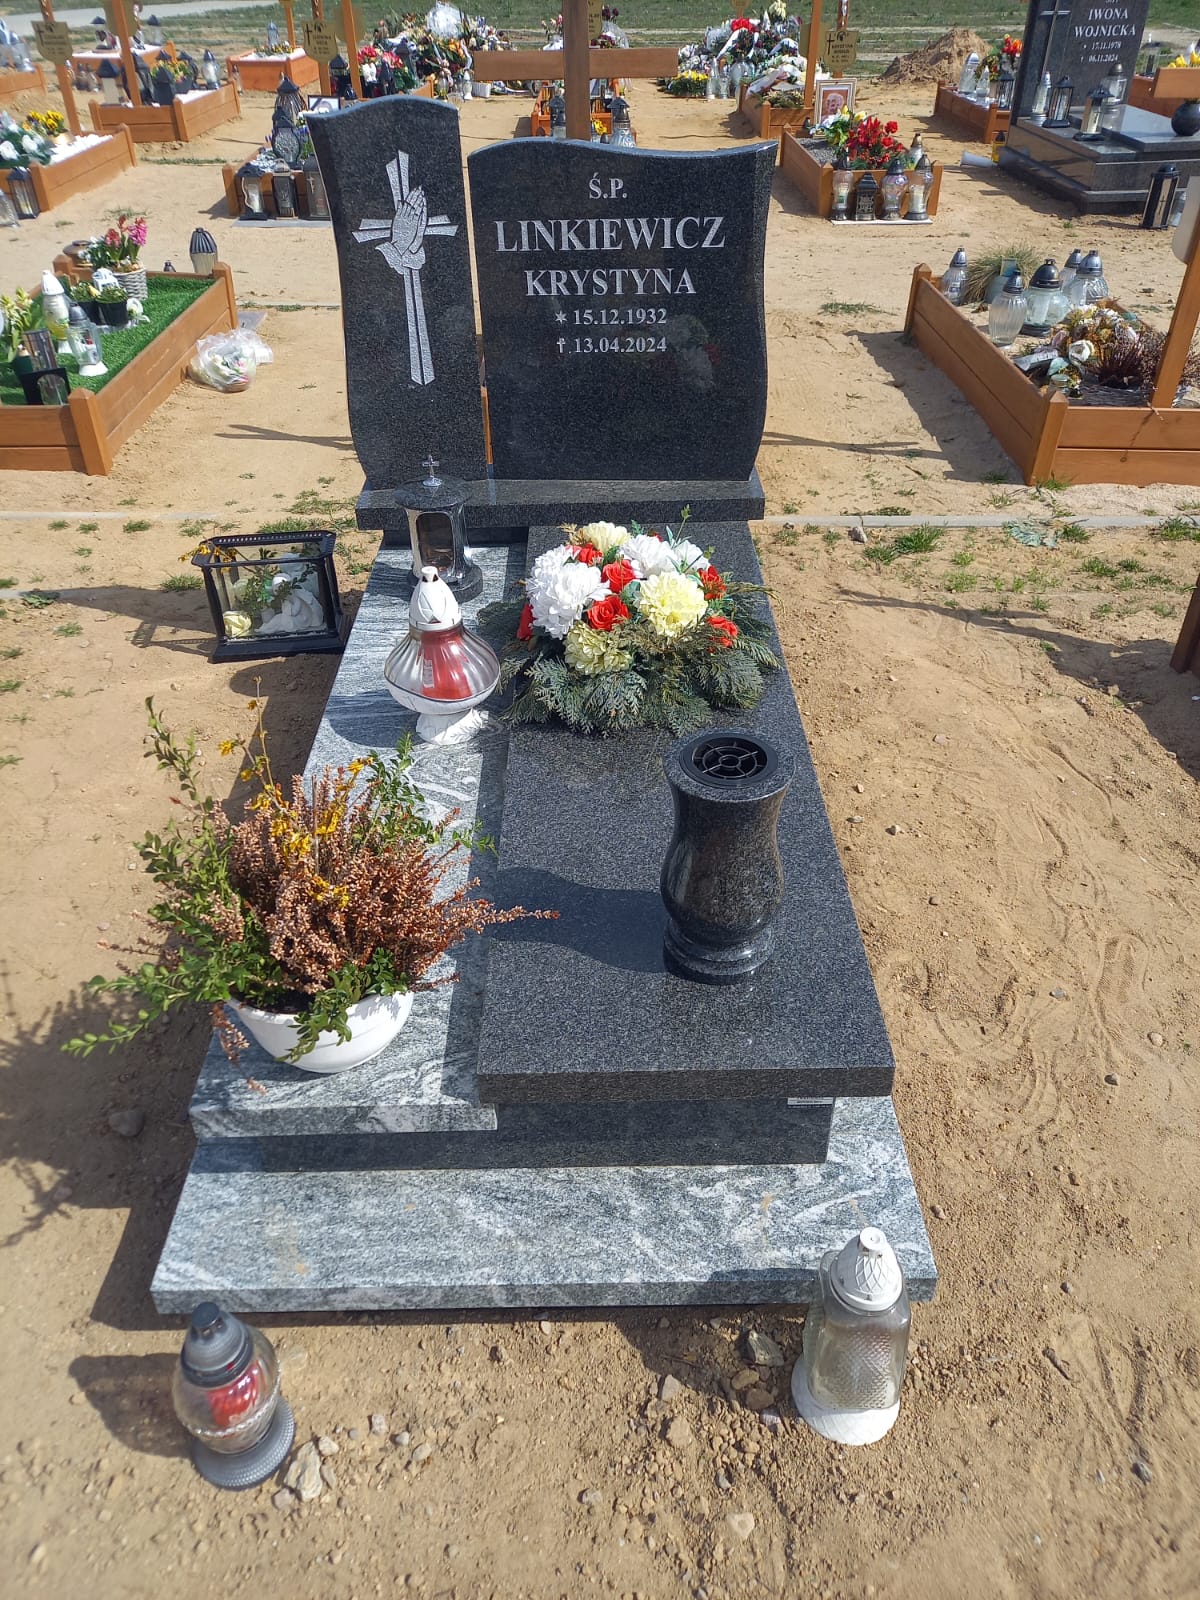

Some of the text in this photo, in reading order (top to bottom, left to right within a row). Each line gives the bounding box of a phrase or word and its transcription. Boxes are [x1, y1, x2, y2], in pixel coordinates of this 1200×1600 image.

[1088, 8, 1128, 20] IWONA
[1074, 24, 1136, 37] WOJNICKA
[588, 172, 628, 199] Ś.P.
[494, 216, 726, 252] LINKIEWICZ
[524, 267, 697, 296] KRYSTYNA
[573, 308, 667, 325] 15.12.1932
[574, 336, 667, 353] 13.04.2024
